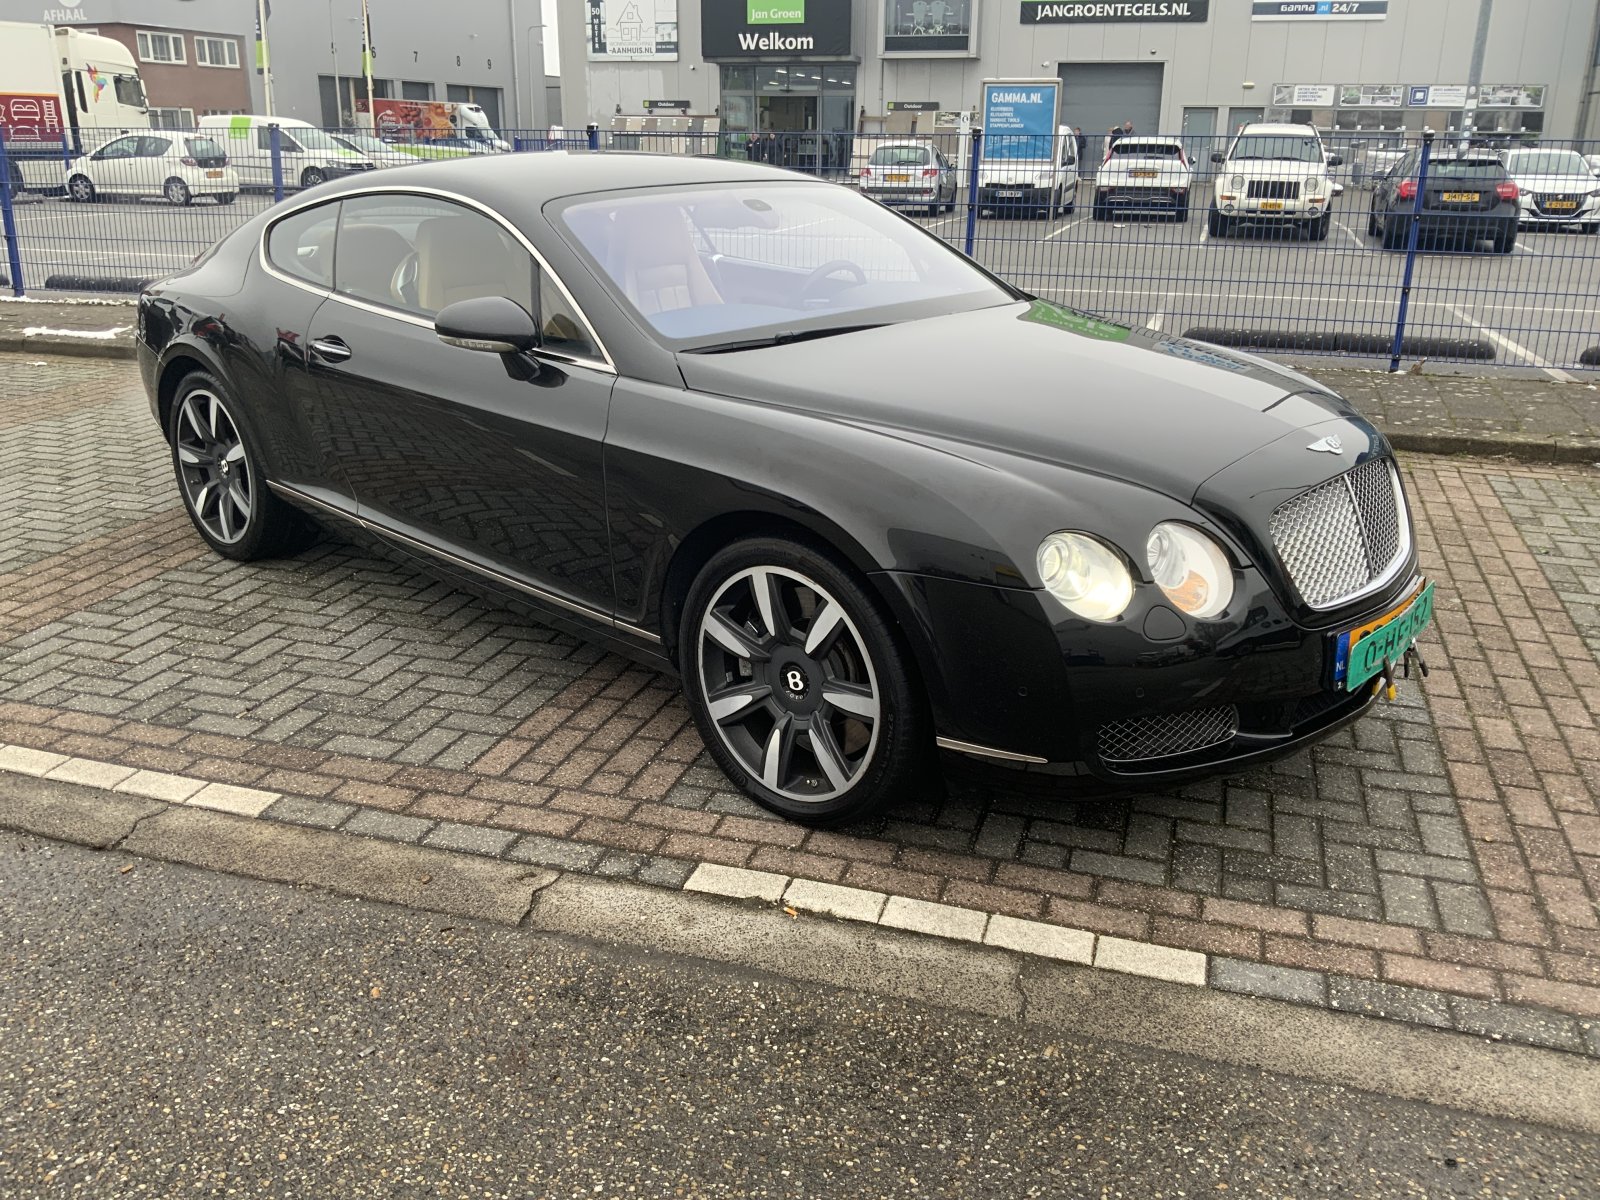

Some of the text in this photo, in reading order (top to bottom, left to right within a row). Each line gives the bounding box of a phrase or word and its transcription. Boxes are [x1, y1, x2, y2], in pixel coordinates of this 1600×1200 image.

[591, 7, 600, 16] 50
[1036, 3, 1191, 20] JANGROENTEGELS.NL
[1332, 3, 1359, 13] 24/7
[43, 8, 87, 21] AFHAAL
[751, 8, 801, 21] Jan Groen
[738, 32, 814, 50] Welkom
[413, 51, 418, 63] 7
[456, 55, 461, 67] 8
[487, 59, 492, 70] 9
[991, 92, 1043, 104] GAMMA.NL
[1335, 661, 1346, 672] NL
[787, 671, 804, 690] B
